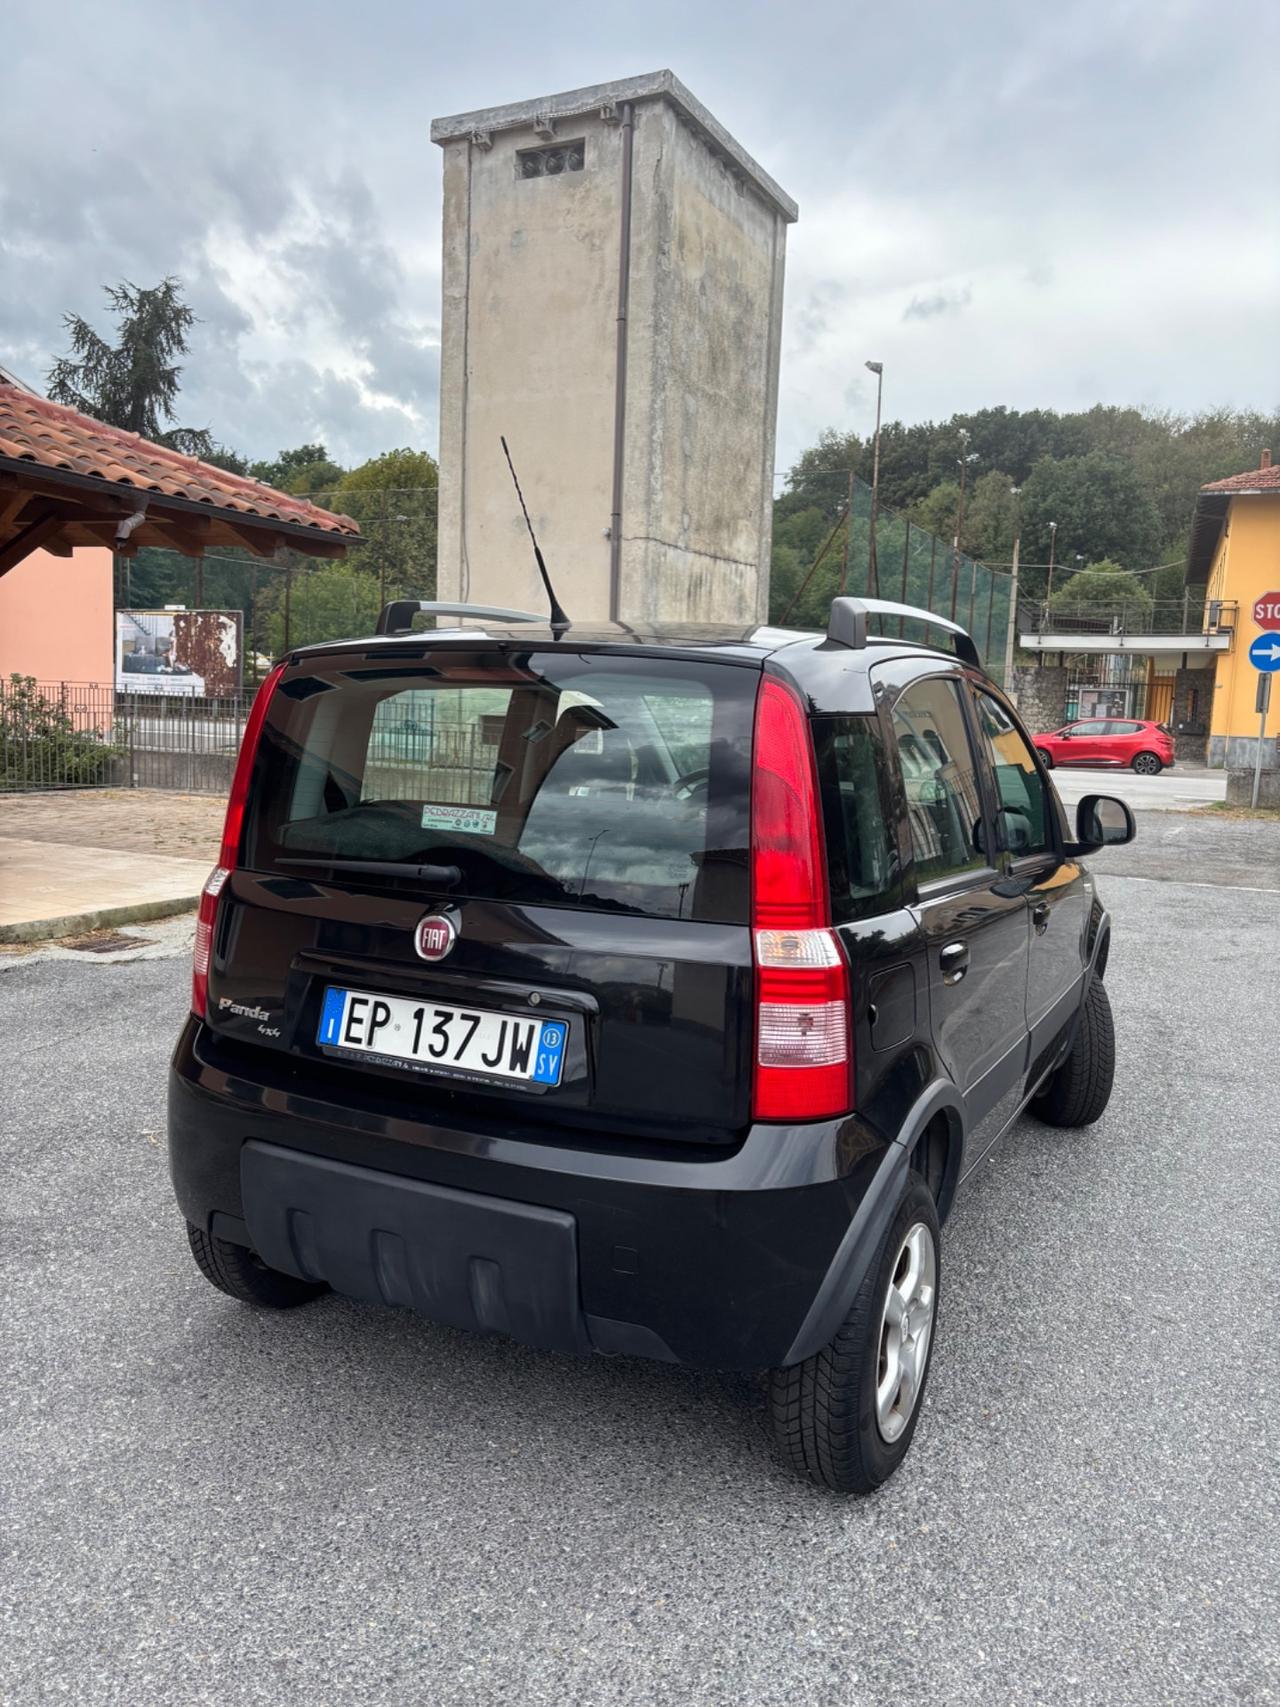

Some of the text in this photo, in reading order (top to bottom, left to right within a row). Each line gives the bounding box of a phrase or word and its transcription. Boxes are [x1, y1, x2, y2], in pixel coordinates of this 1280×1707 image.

[422, 927, 446, 950] FIAT
[219, 997, 270, 1021] Panda
[257, 1024, 281, 1037] 4x4
[343, 997, 391, 1047] EP
[546, 1031, 558, 1045] 13
[537, 1053, 558, 1076] SV
